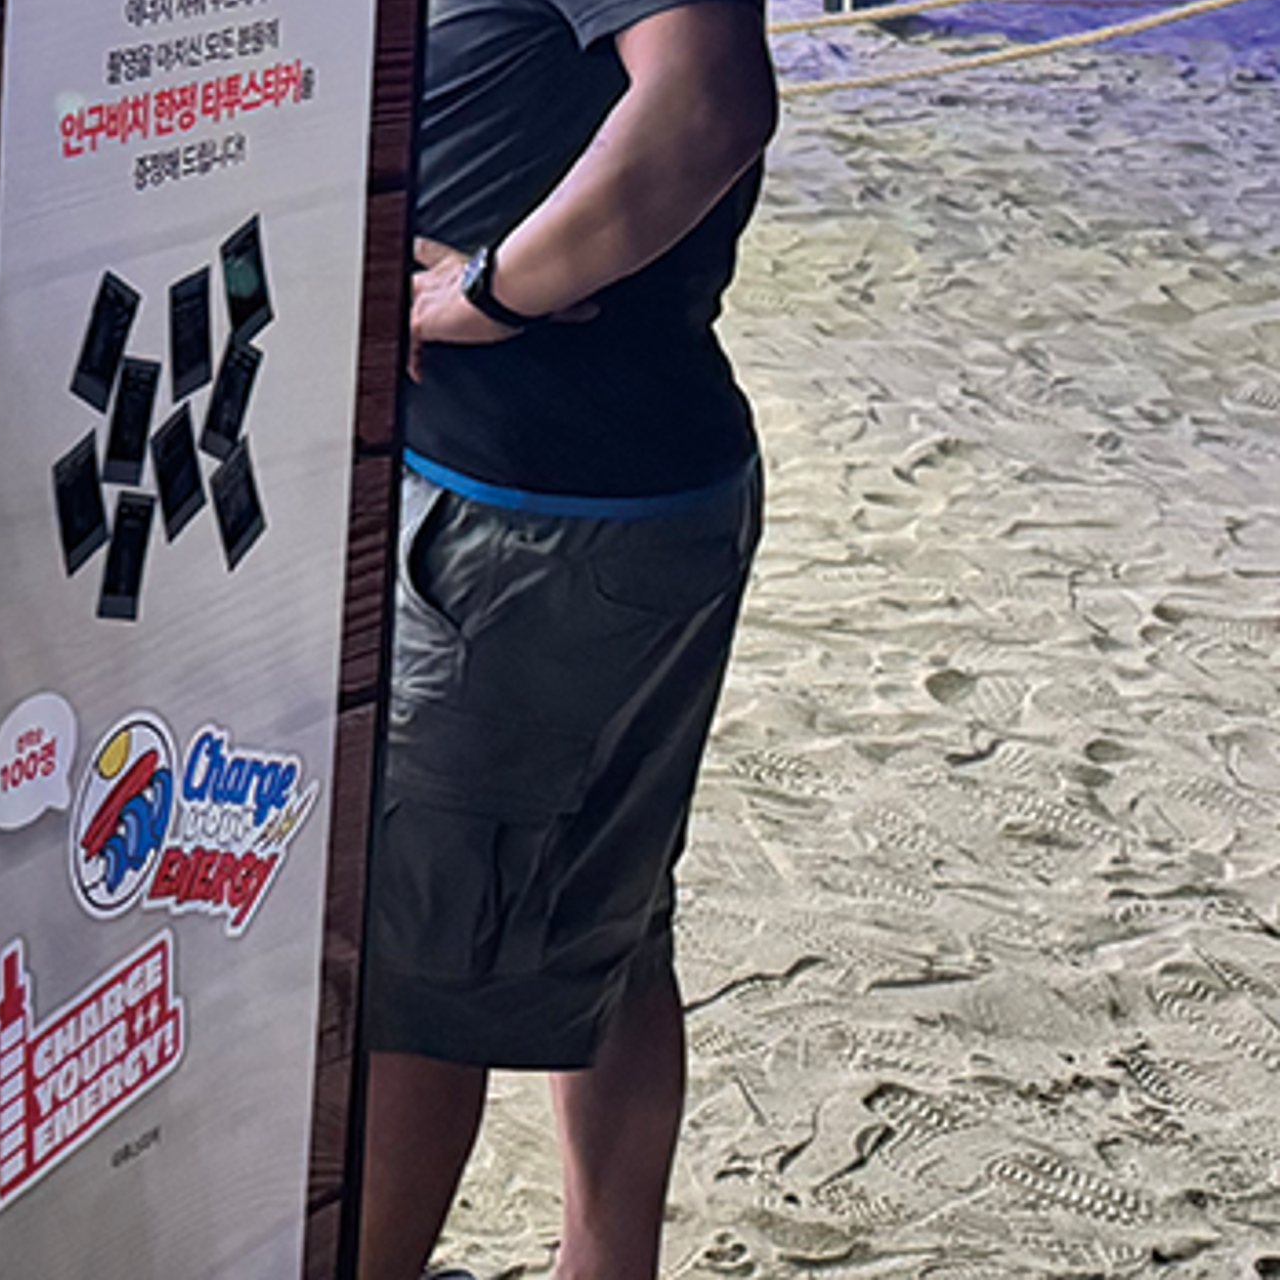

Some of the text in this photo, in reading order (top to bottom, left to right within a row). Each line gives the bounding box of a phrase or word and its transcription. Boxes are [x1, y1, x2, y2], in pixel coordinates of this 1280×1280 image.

[153, 82, 199, 138] 한정
[182, 731, 297, 829] Charge
[147, 845, 280, 927] ENERGY
[33, 950, 163, 1080] CHARGE
[33, 1018, 175, 1165] ENERGY!
[34, 1017, 128, 1117] YOUR
